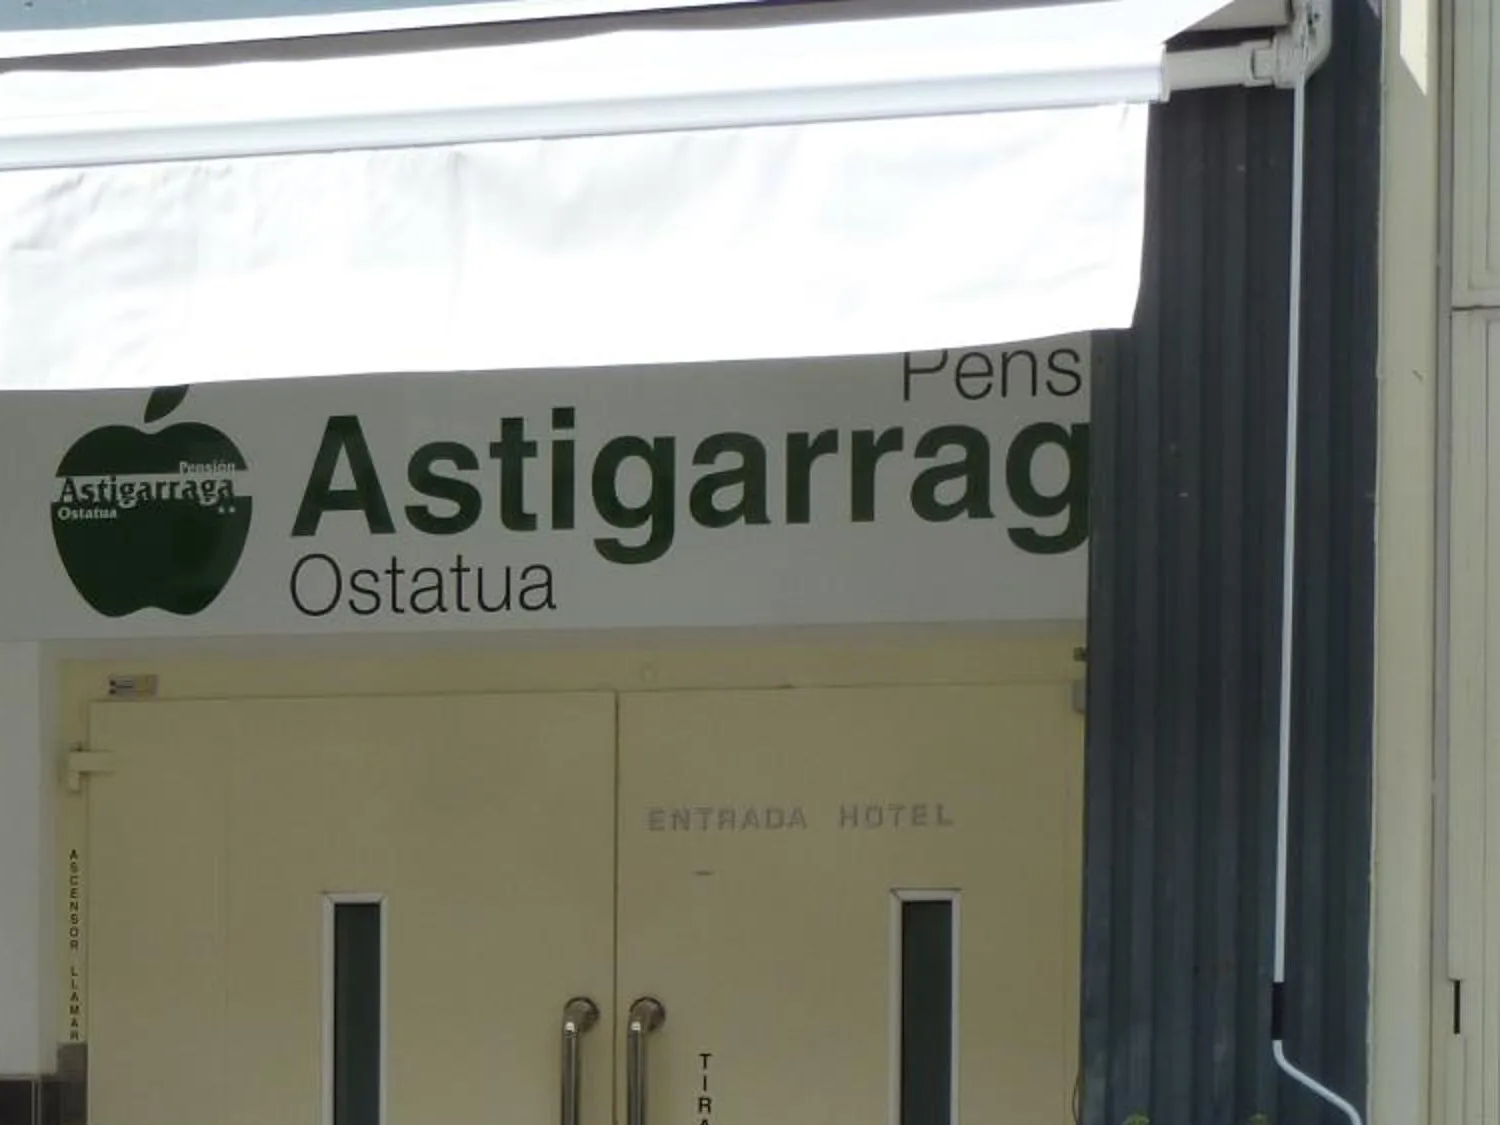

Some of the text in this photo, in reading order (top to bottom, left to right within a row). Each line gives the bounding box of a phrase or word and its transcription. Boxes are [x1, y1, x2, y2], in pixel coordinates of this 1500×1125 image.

[903, 347, 1083, 402] Pens
[60, 475, 235, 508] Astigarraga
[291, 406, 1089, 566] Astigarrag
[290, 552, 557, 617] Ostatua
[647, 802, 955, 832] ENTRADA HOTEL
[69, 848, 79, 950] ASCENSOR
